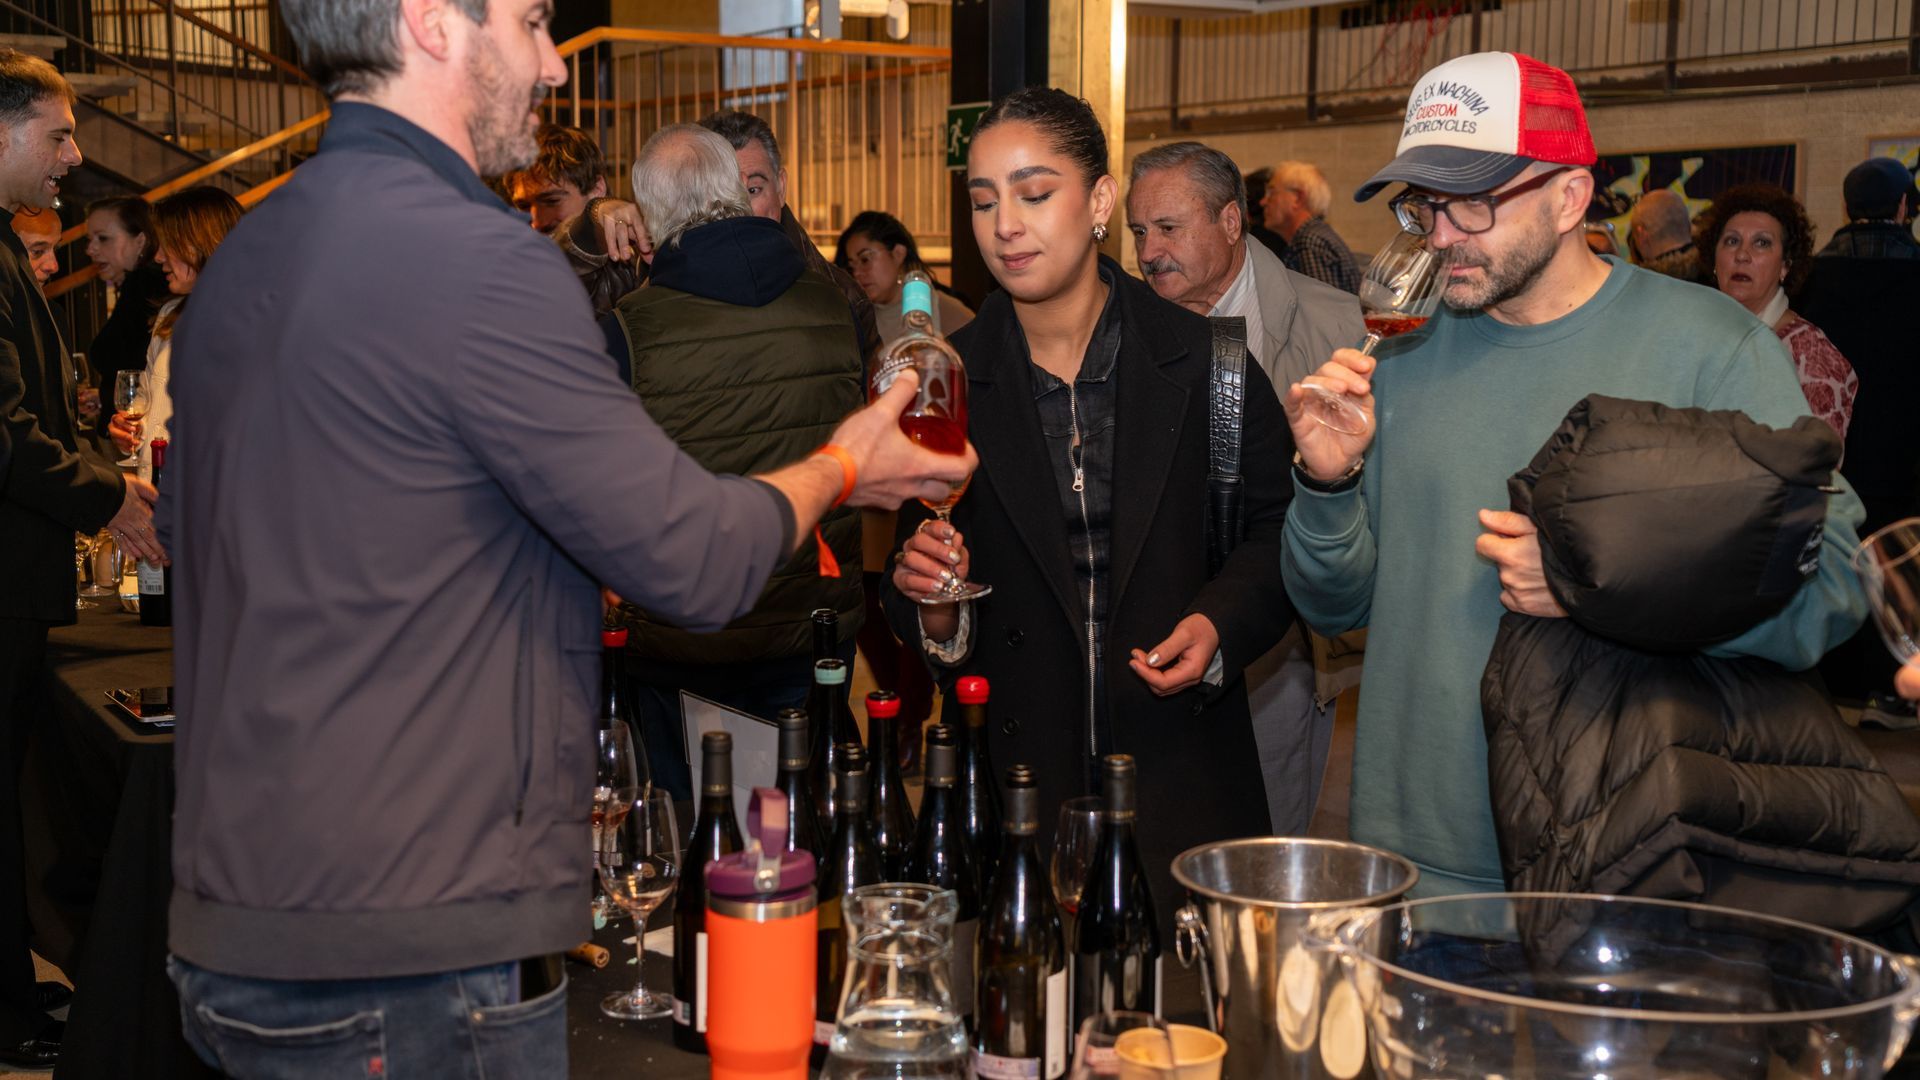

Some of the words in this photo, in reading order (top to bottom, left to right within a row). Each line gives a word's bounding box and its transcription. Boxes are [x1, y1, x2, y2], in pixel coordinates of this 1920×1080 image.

[1416, 103, 1458, 120] CUSTOM
[1424, 83, 1435, 101] EX
[1437, 81, 1490, 116] MACHINA
